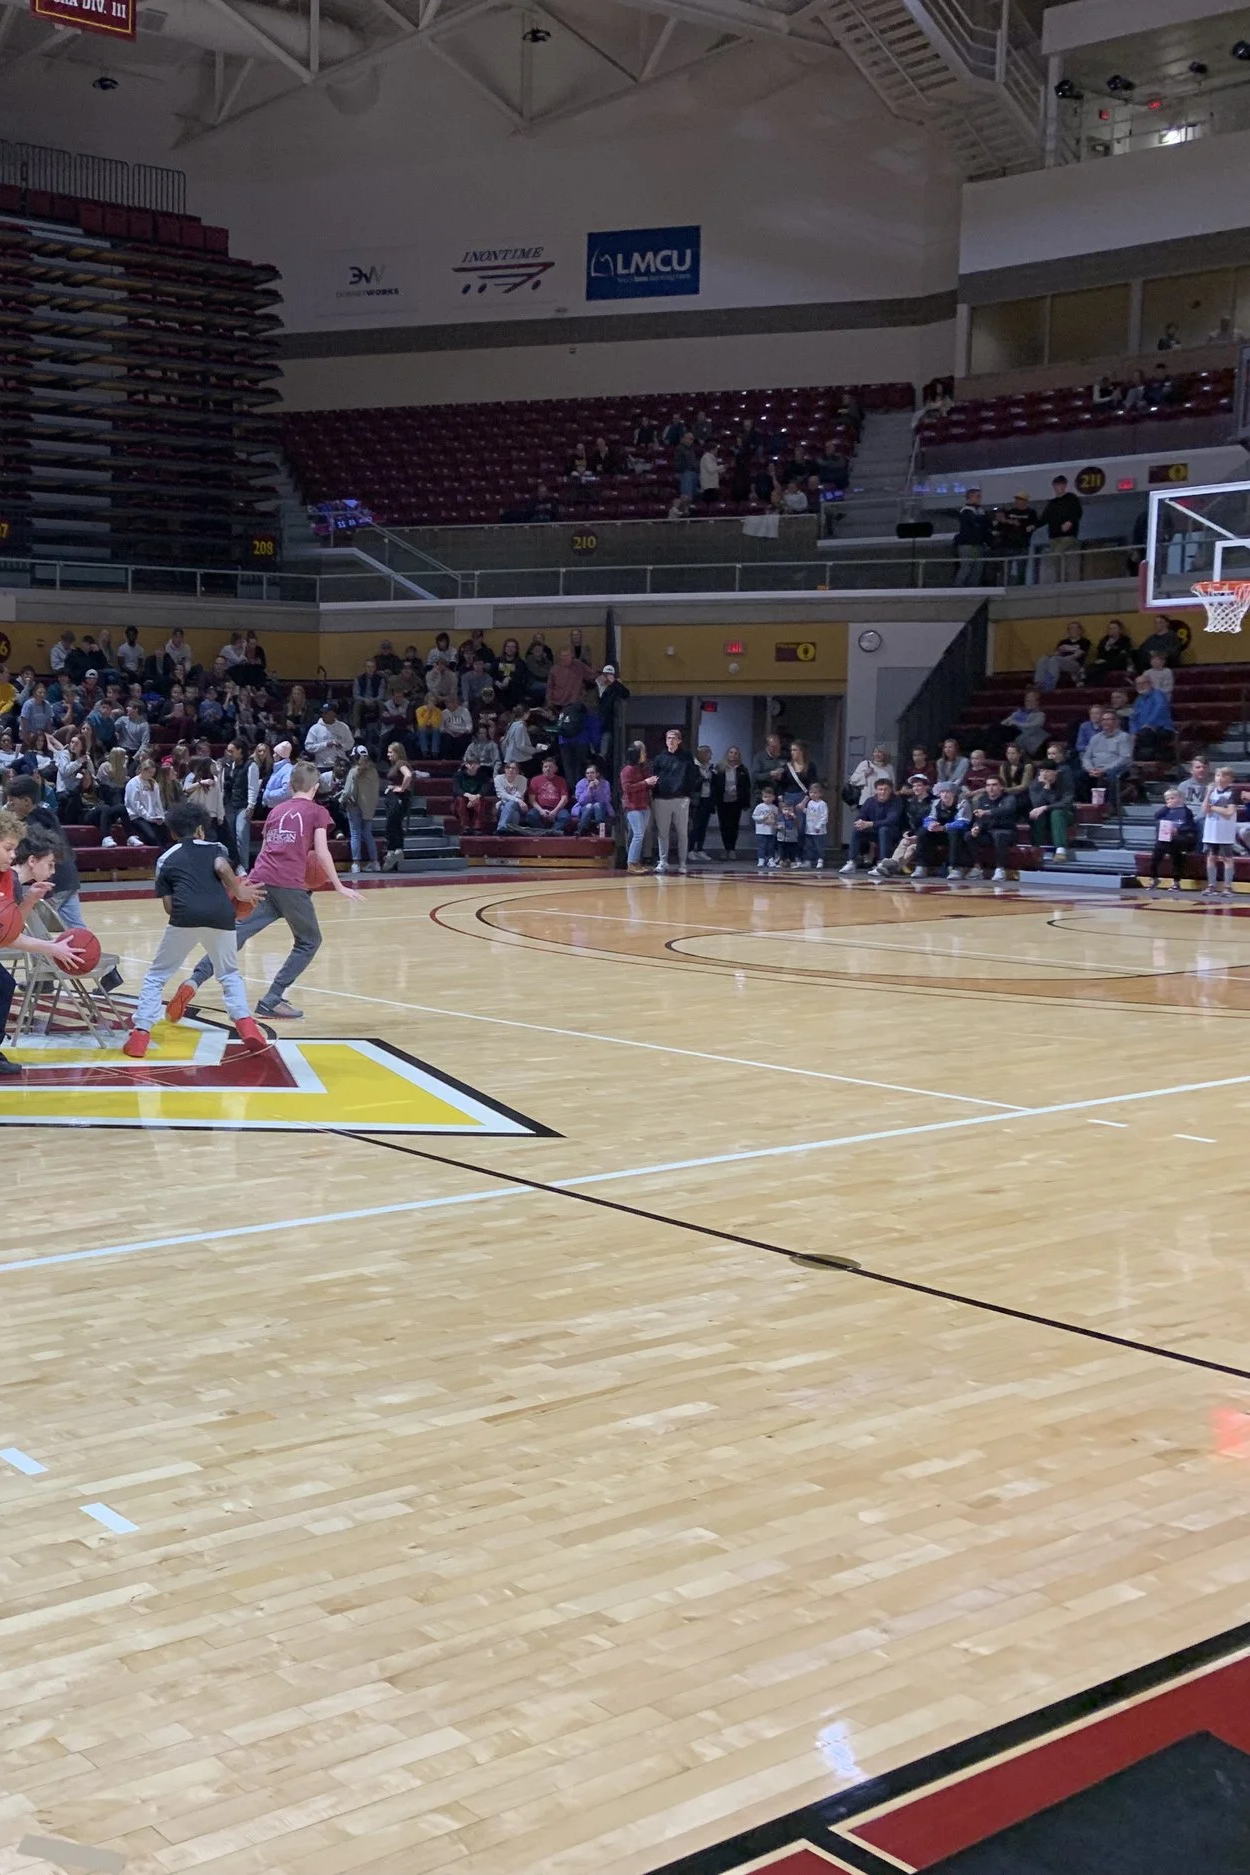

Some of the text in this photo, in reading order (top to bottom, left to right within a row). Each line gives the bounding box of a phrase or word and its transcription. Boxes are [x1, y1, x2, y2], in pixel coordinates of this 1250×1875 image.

[111, 1, 126, 18] III
[462, 246, 544, 263] INONTIME
[616, 248, 692, 274] LMCU
[1081, 473, 1102, 488] 211
[253, 540, 274, 555] 208
[573, 535, 596, 549] 210
